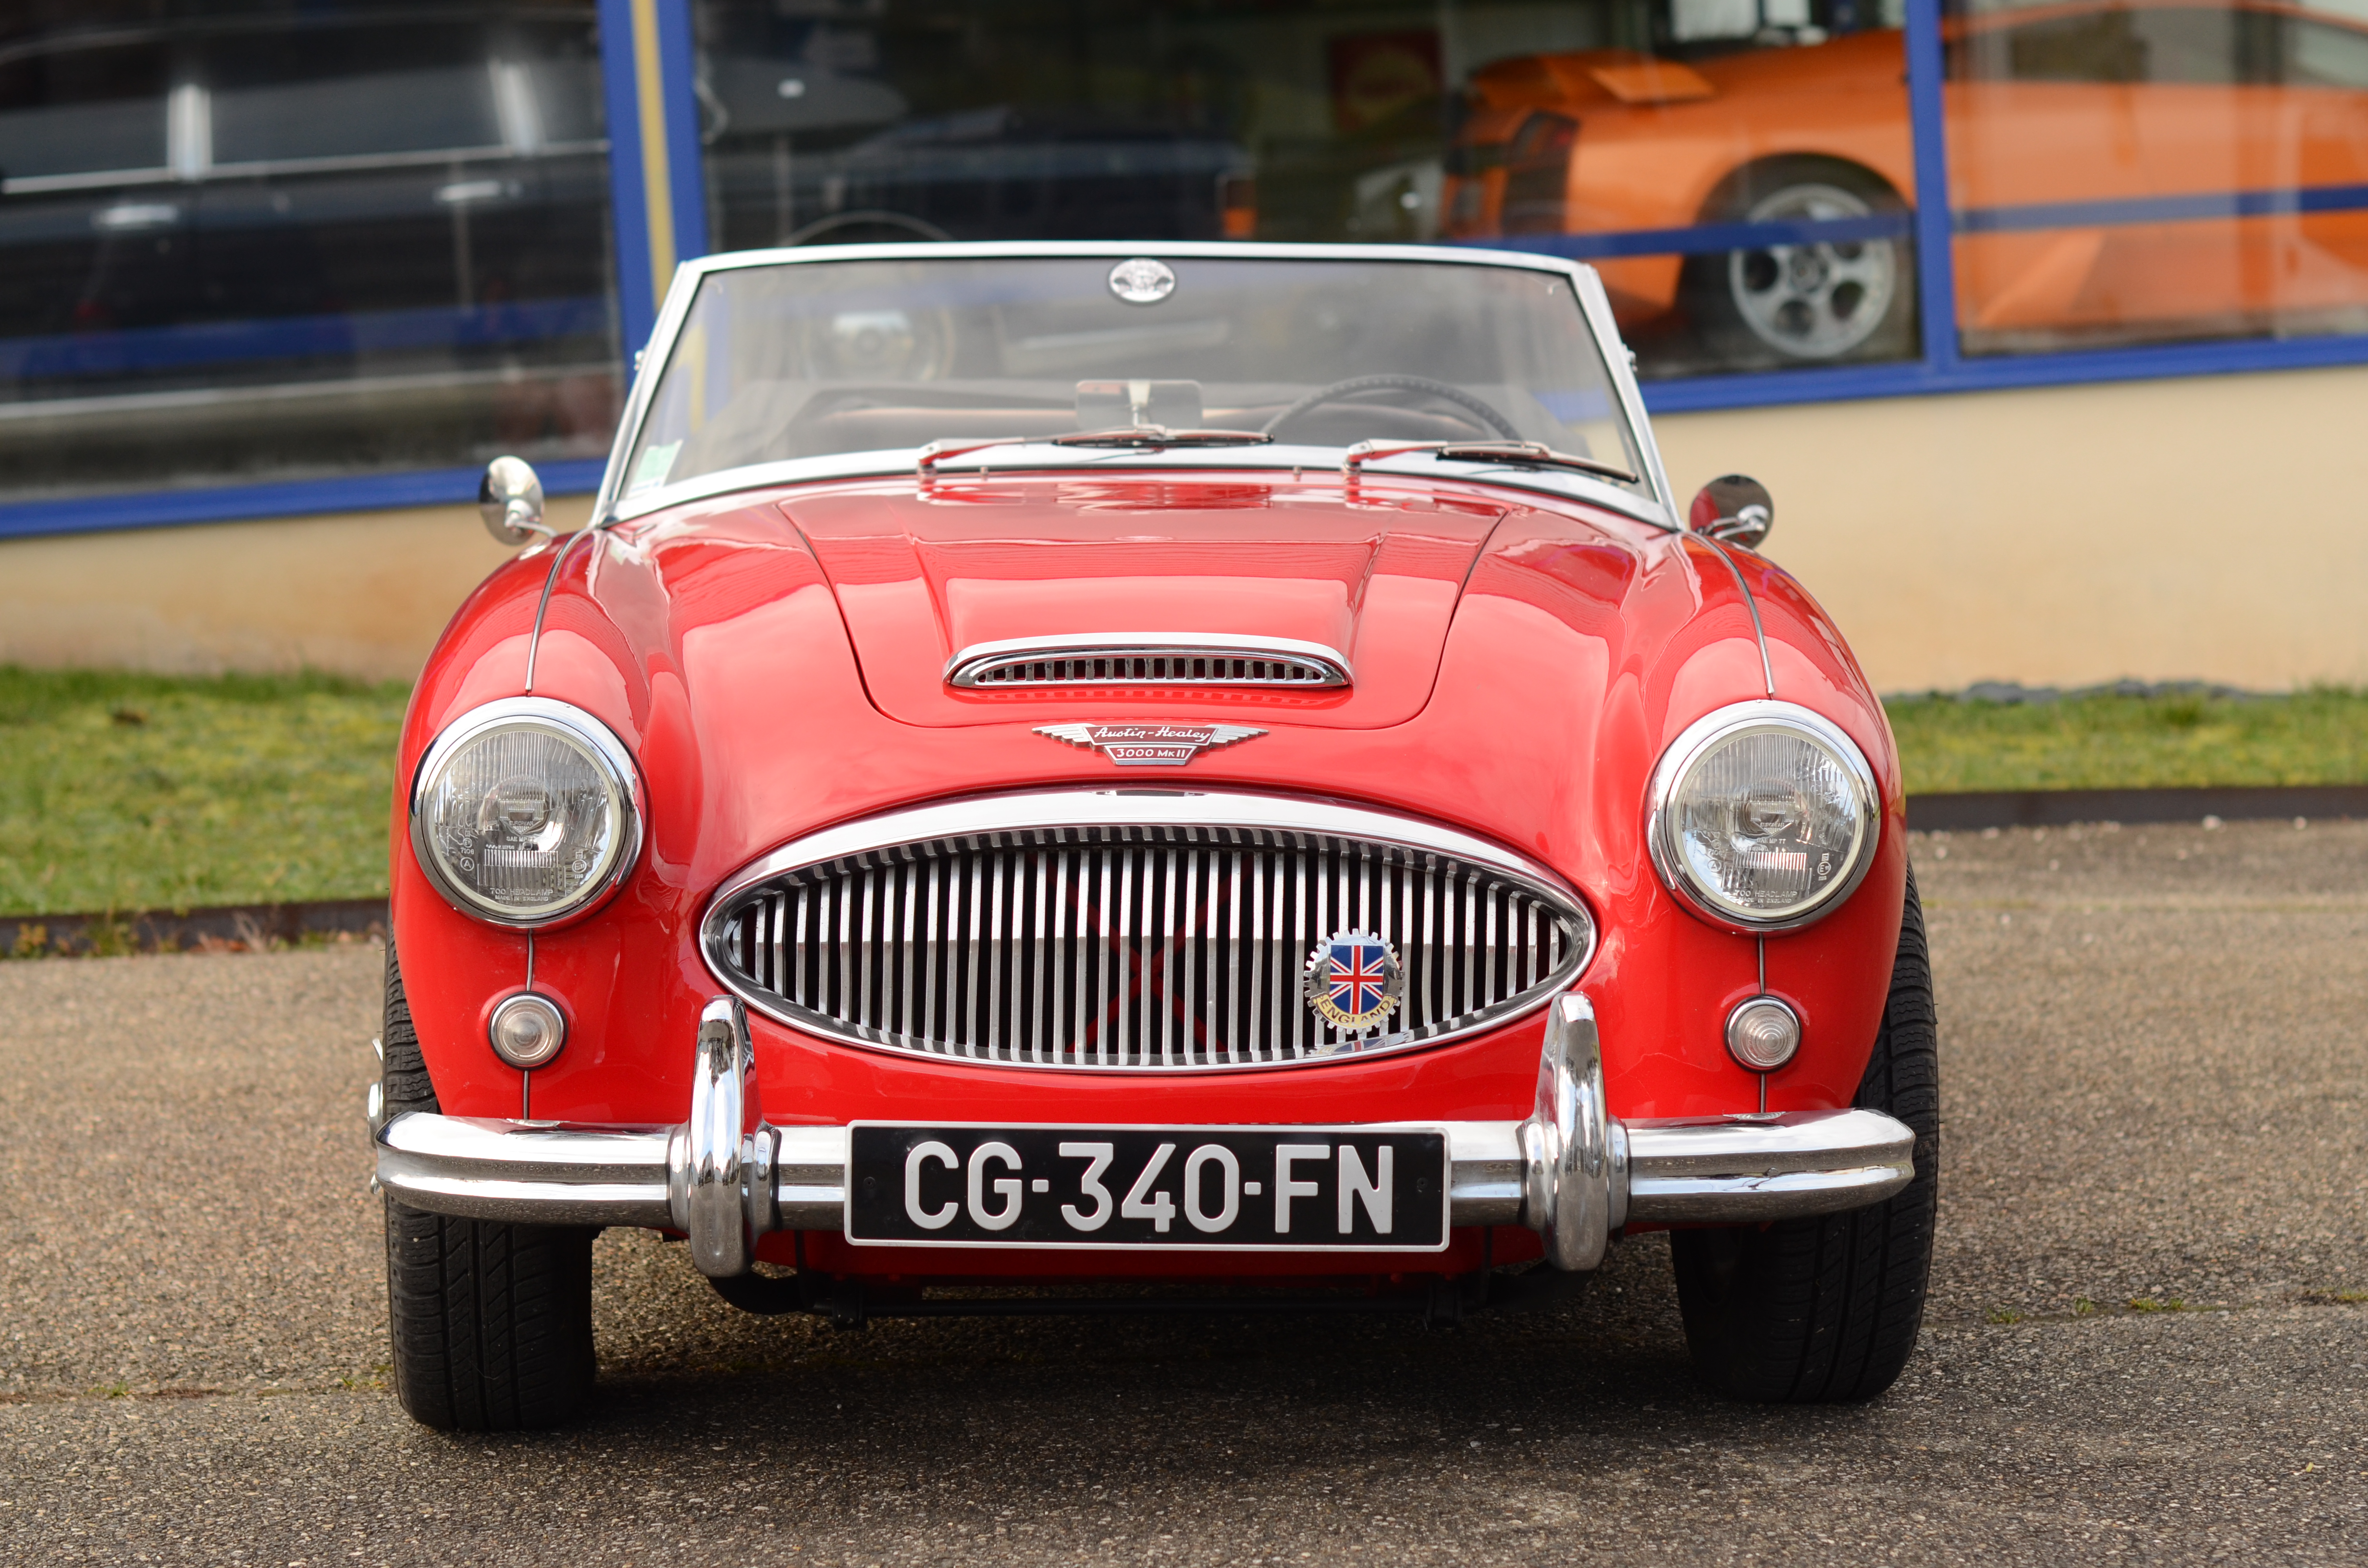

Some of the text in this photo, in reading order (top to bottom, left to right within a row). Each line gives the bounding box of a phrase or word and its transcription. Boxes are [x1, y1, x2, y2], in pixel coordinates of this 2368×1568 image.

[1094, 726, 1211, 743] Austin-Healey
[1116, 748, 1154, 758] 3000
[464, 859, 471, 869] A
[510, 888, 554, 896] HEADLAMP
[1755, 890, 1798, 898] HEADLAMP
[1320, 999, 1391, 1026] ENGLAND
[904, 1140, 1394, 1234] CG-340-FN
